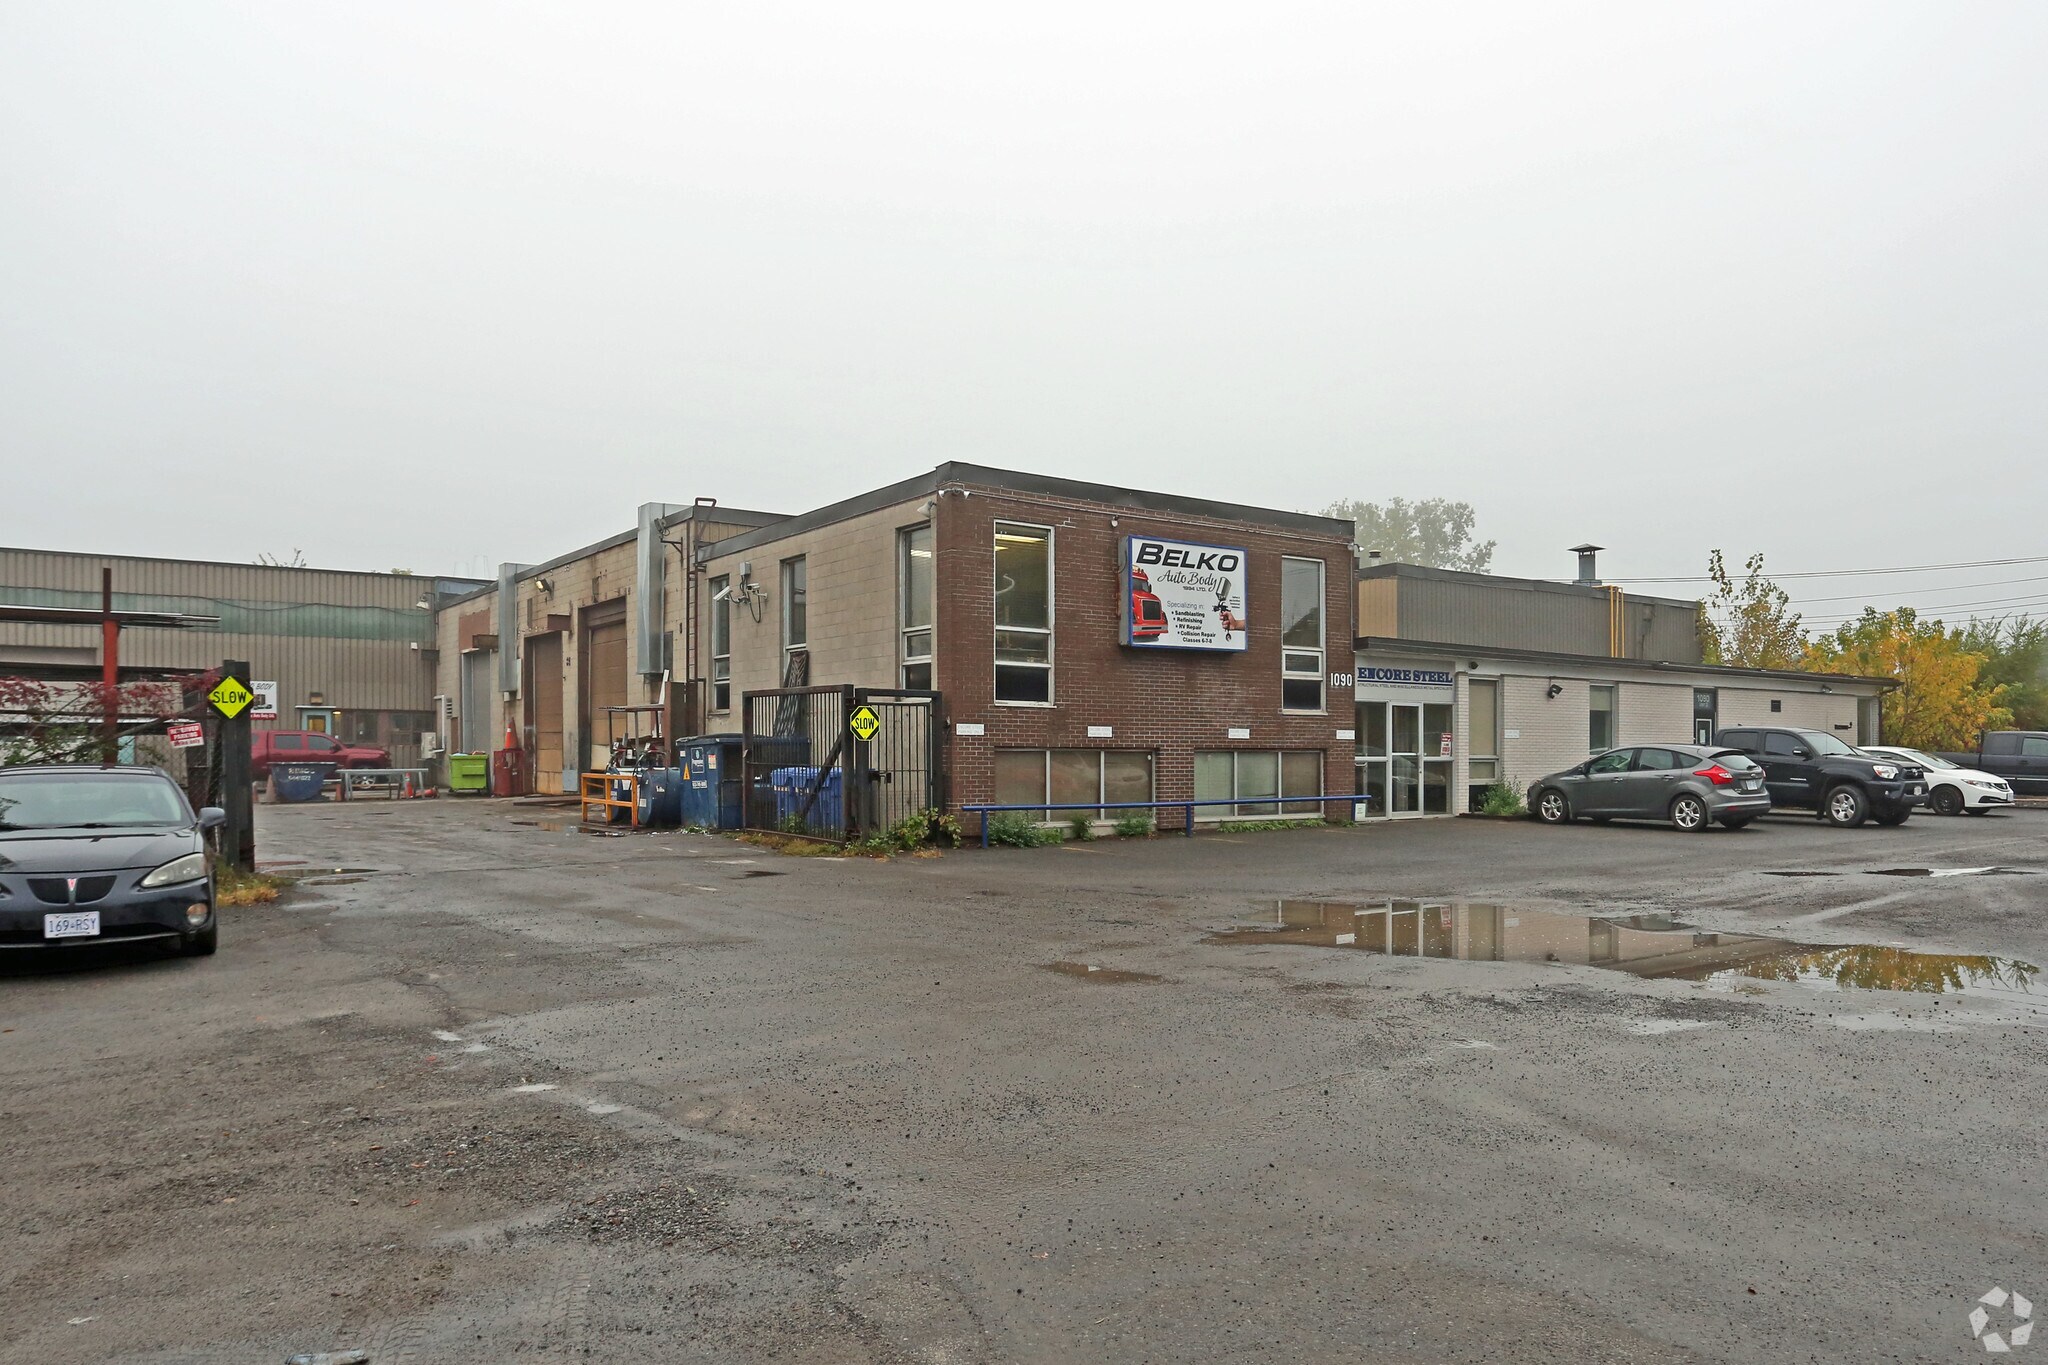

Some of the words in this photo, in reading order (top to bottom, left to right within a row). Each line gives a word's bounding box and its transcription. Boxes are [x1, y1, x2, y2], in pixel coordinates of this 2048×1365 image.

[1136, 542, 1239, 572] BELKO
[1157, 569, 1187, 584] Auto
[1187, 571, 1218, 592] Body
[1166, 601, 1198, 610] Specializing
[1174, 610, 1205, 618] Sandblasting
[1330, 672, 1353, 687] 1090
[1357, 667, 1412, 681] ENCORE
[1412, 670, 1453, 683] STEEL
[213, 691, 247, 704] SLOW
[855, 717, 875, 730] SLOW
